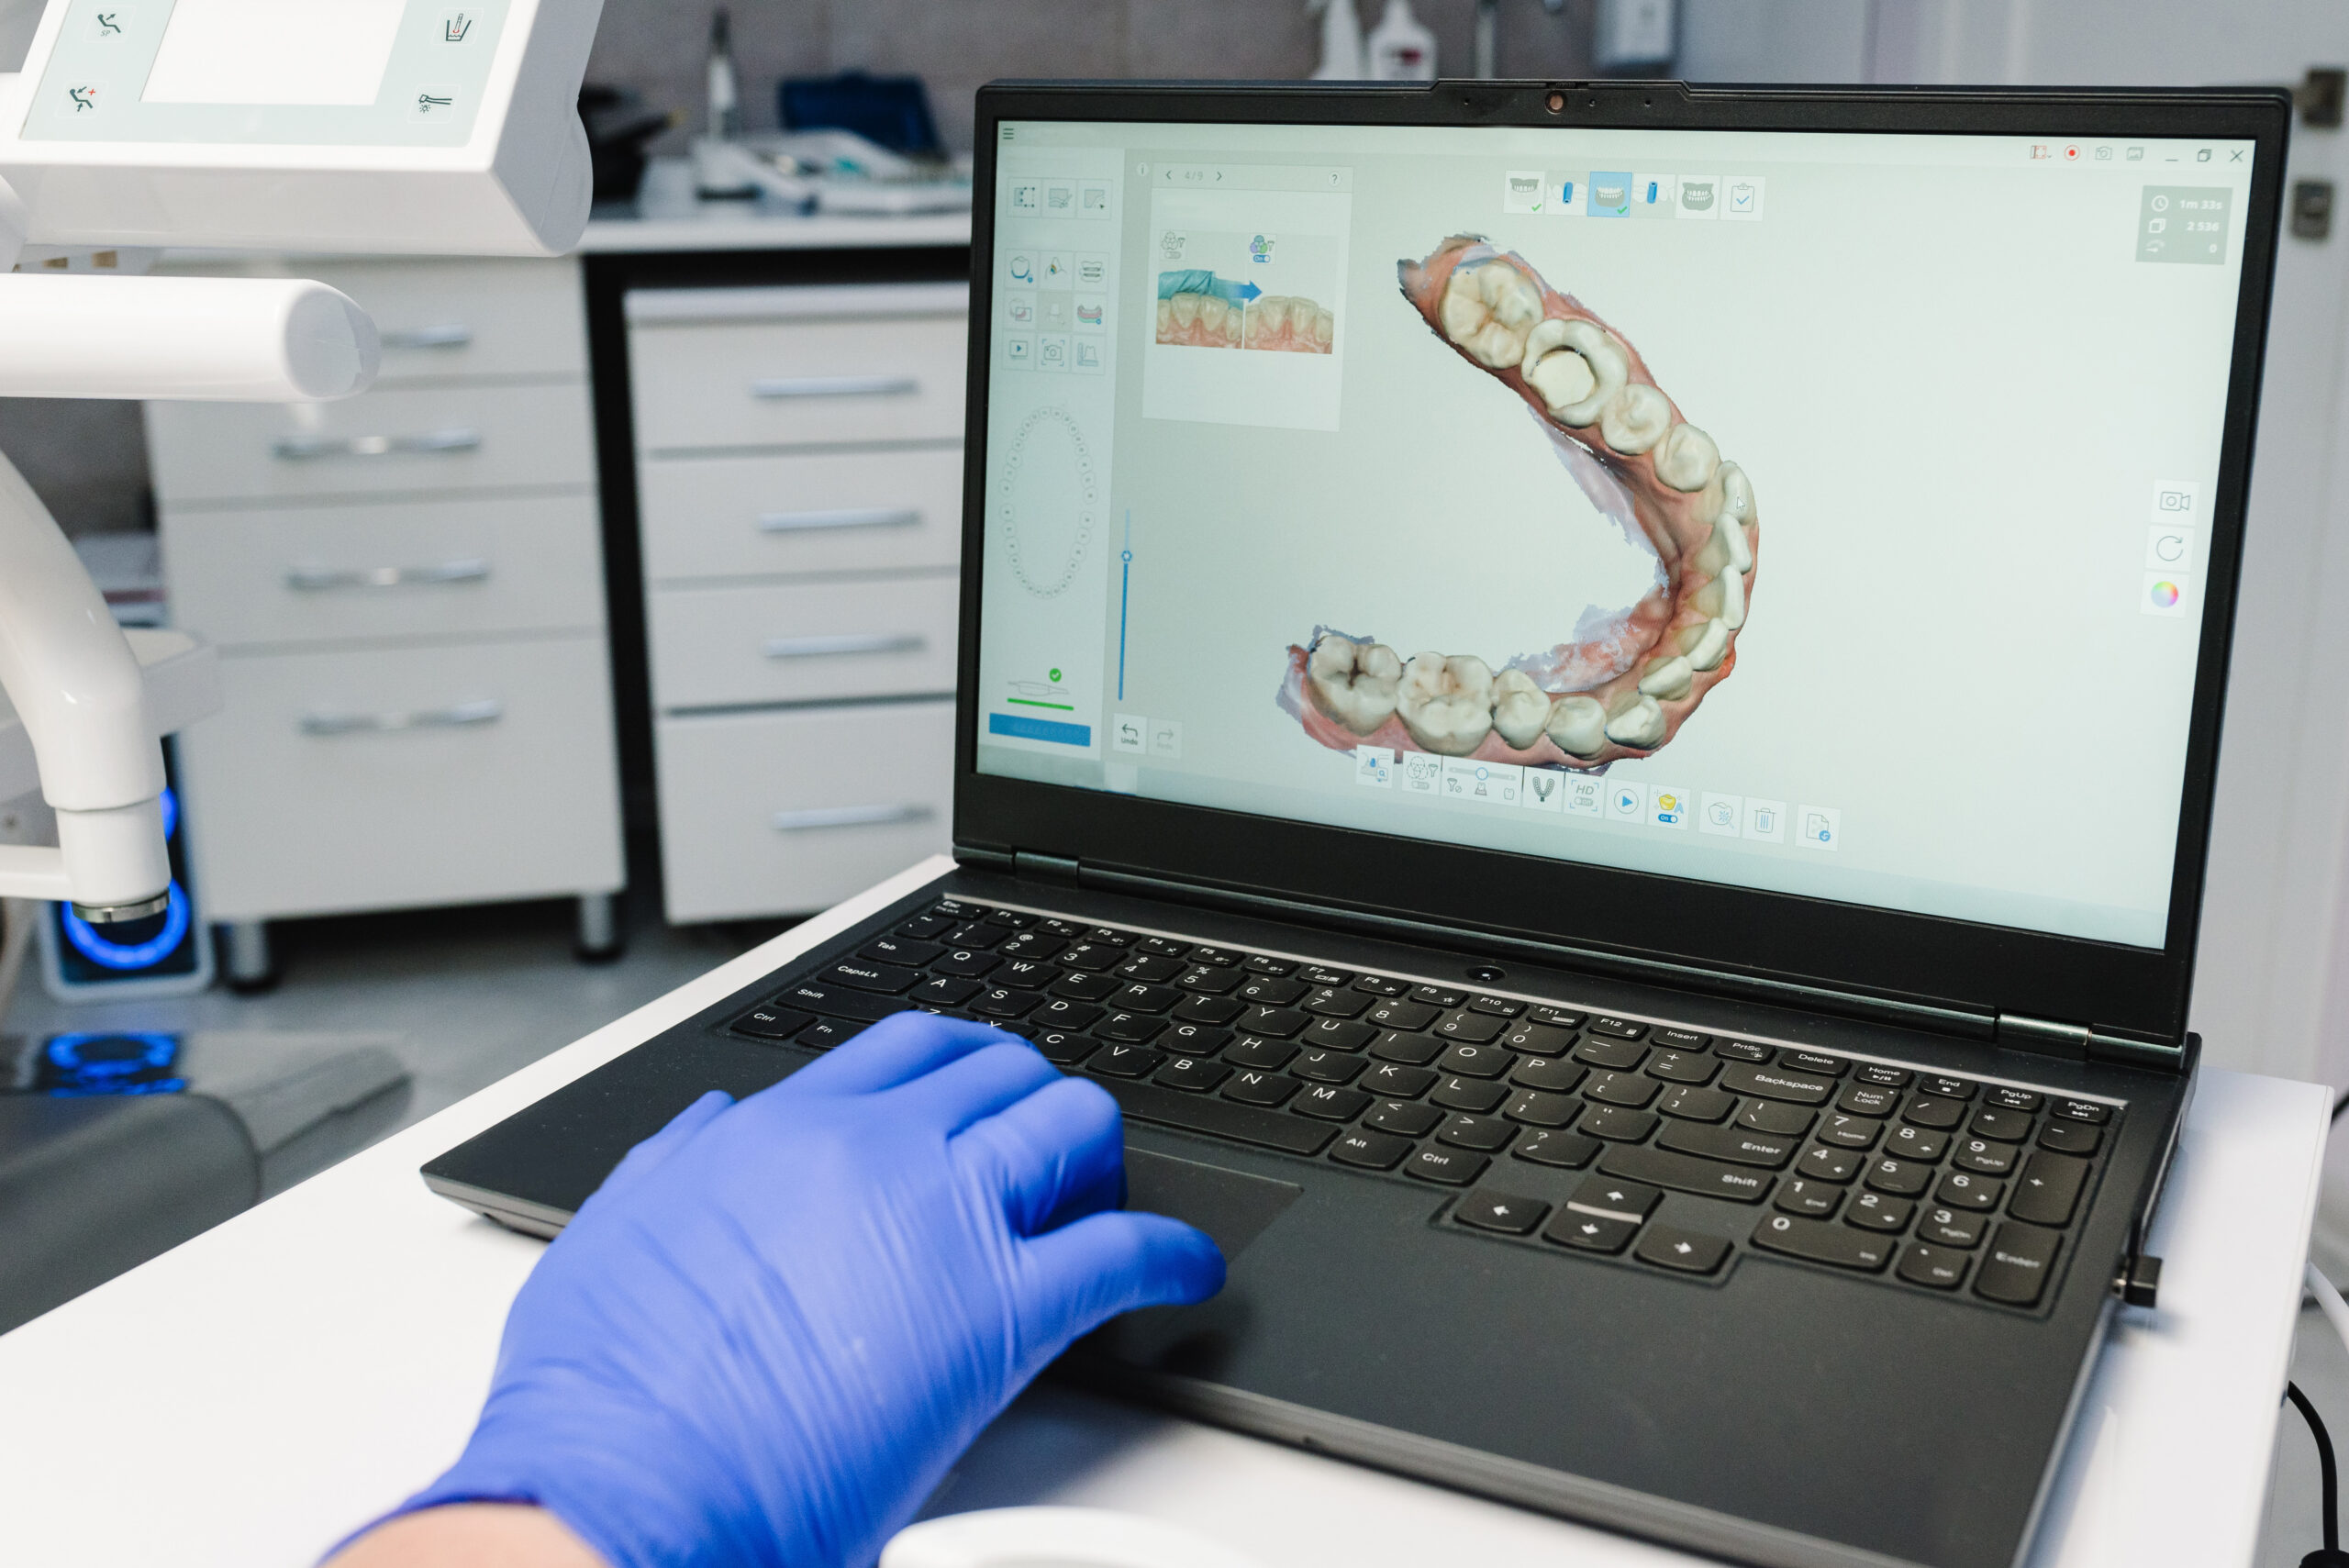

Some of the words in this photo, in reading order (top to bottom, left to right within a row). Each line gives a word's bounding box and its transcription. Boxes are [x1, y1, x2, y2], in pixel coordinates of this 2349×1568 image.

[2179, 200, 2198, 209] 1m
[2200, 200, 2222, 209] 33s
[2210, 244, 2217, 253] 0
[1575, 785, 1595, 795] HD
[953, 952, 971, 961] Q
[838, 966, 878, 977] CapsLk
[1013, 962, 1034, 972] W
[930, 979, 946, 987] A
[1069, 973, 1086, 983] E
[798, 989, 824, 998] Shift
[992, 990, 1008, 998] S
[1130, 985, 1147, 995] R
[1051, 1001, 1068, 1010] D
[1197, 996, 1210, 1005] T
[754, 1013, 775, 1021] Ctrl
[1261, 1007, 1275, 1017] Y
[1321, 1020, 1340, 1029] U
[1601, 1018, 1621, 1027] F12
[1179, 1027, 1196, 1036] G
[1667, 1031, 1698, 1040] Insert
[1047, 1035, 1063, 1043] C
[1242, 1038, 1262, 1049] H
[1113, 1047, 1129, 1055] V
[1732, 1041, 1761, 1051] PrtSc
[1459, 1048, 1476, 1056] O
[1529, 1059, 1545, 1067] P
[1798, 1054, 1833, 1064] Delete
[1174, 1060, 1192, 1069] B
[1380, 1065, 1398, 1076] K
[1868, 1066, 1901, 1077] Home
[1241, 1073, 1262, 1084] N
[1755, 1074, 1823, 1090] Backspace
[1938, 1078, 1960, 1087] End
[1450, 1079, 1461, 1089] L
[1313, 1087, 1335, 1099] M
[1856, 1091, 1883, 1100] Num
[2000, 1089, 2032, 1100] PgUp
[1854, 1096, 1881, 1106] Lock
[2067, 1101, 2099, 1112] PgDn
[1835, 1116, 1849, 1125] 7
[1837, 1130, 1866, 1140] Home
[1899, 1129, 1915, 1139] 8
[1347, 1139, 1366, 1148] Alt
[1742, 1141, 1781, 1154] Enter
[1970, 1141, 1986, 1151] 9
[1422, 1153, 1449, 1164] Ctrl
[1813, 1150, 1828, 1159] 4
[1881, 1161, 1897, 1172] 5
[1975, 1156, 2004, 1167] PgUp
[1722, 1175, 1757, 1186] Shift
[1953, 1175, 1969, 1186] 6
[1795, 1182, 1803, 1192] 1
[1805, 1198, 1827, 1207] End
[1860, 1195, 1878, 1207] 2
[1934, 1210, 1952, 1223] 3
[1773, 1218, 1790, 1230] 0
[1995, 1251, 2041, 1268] Enter
